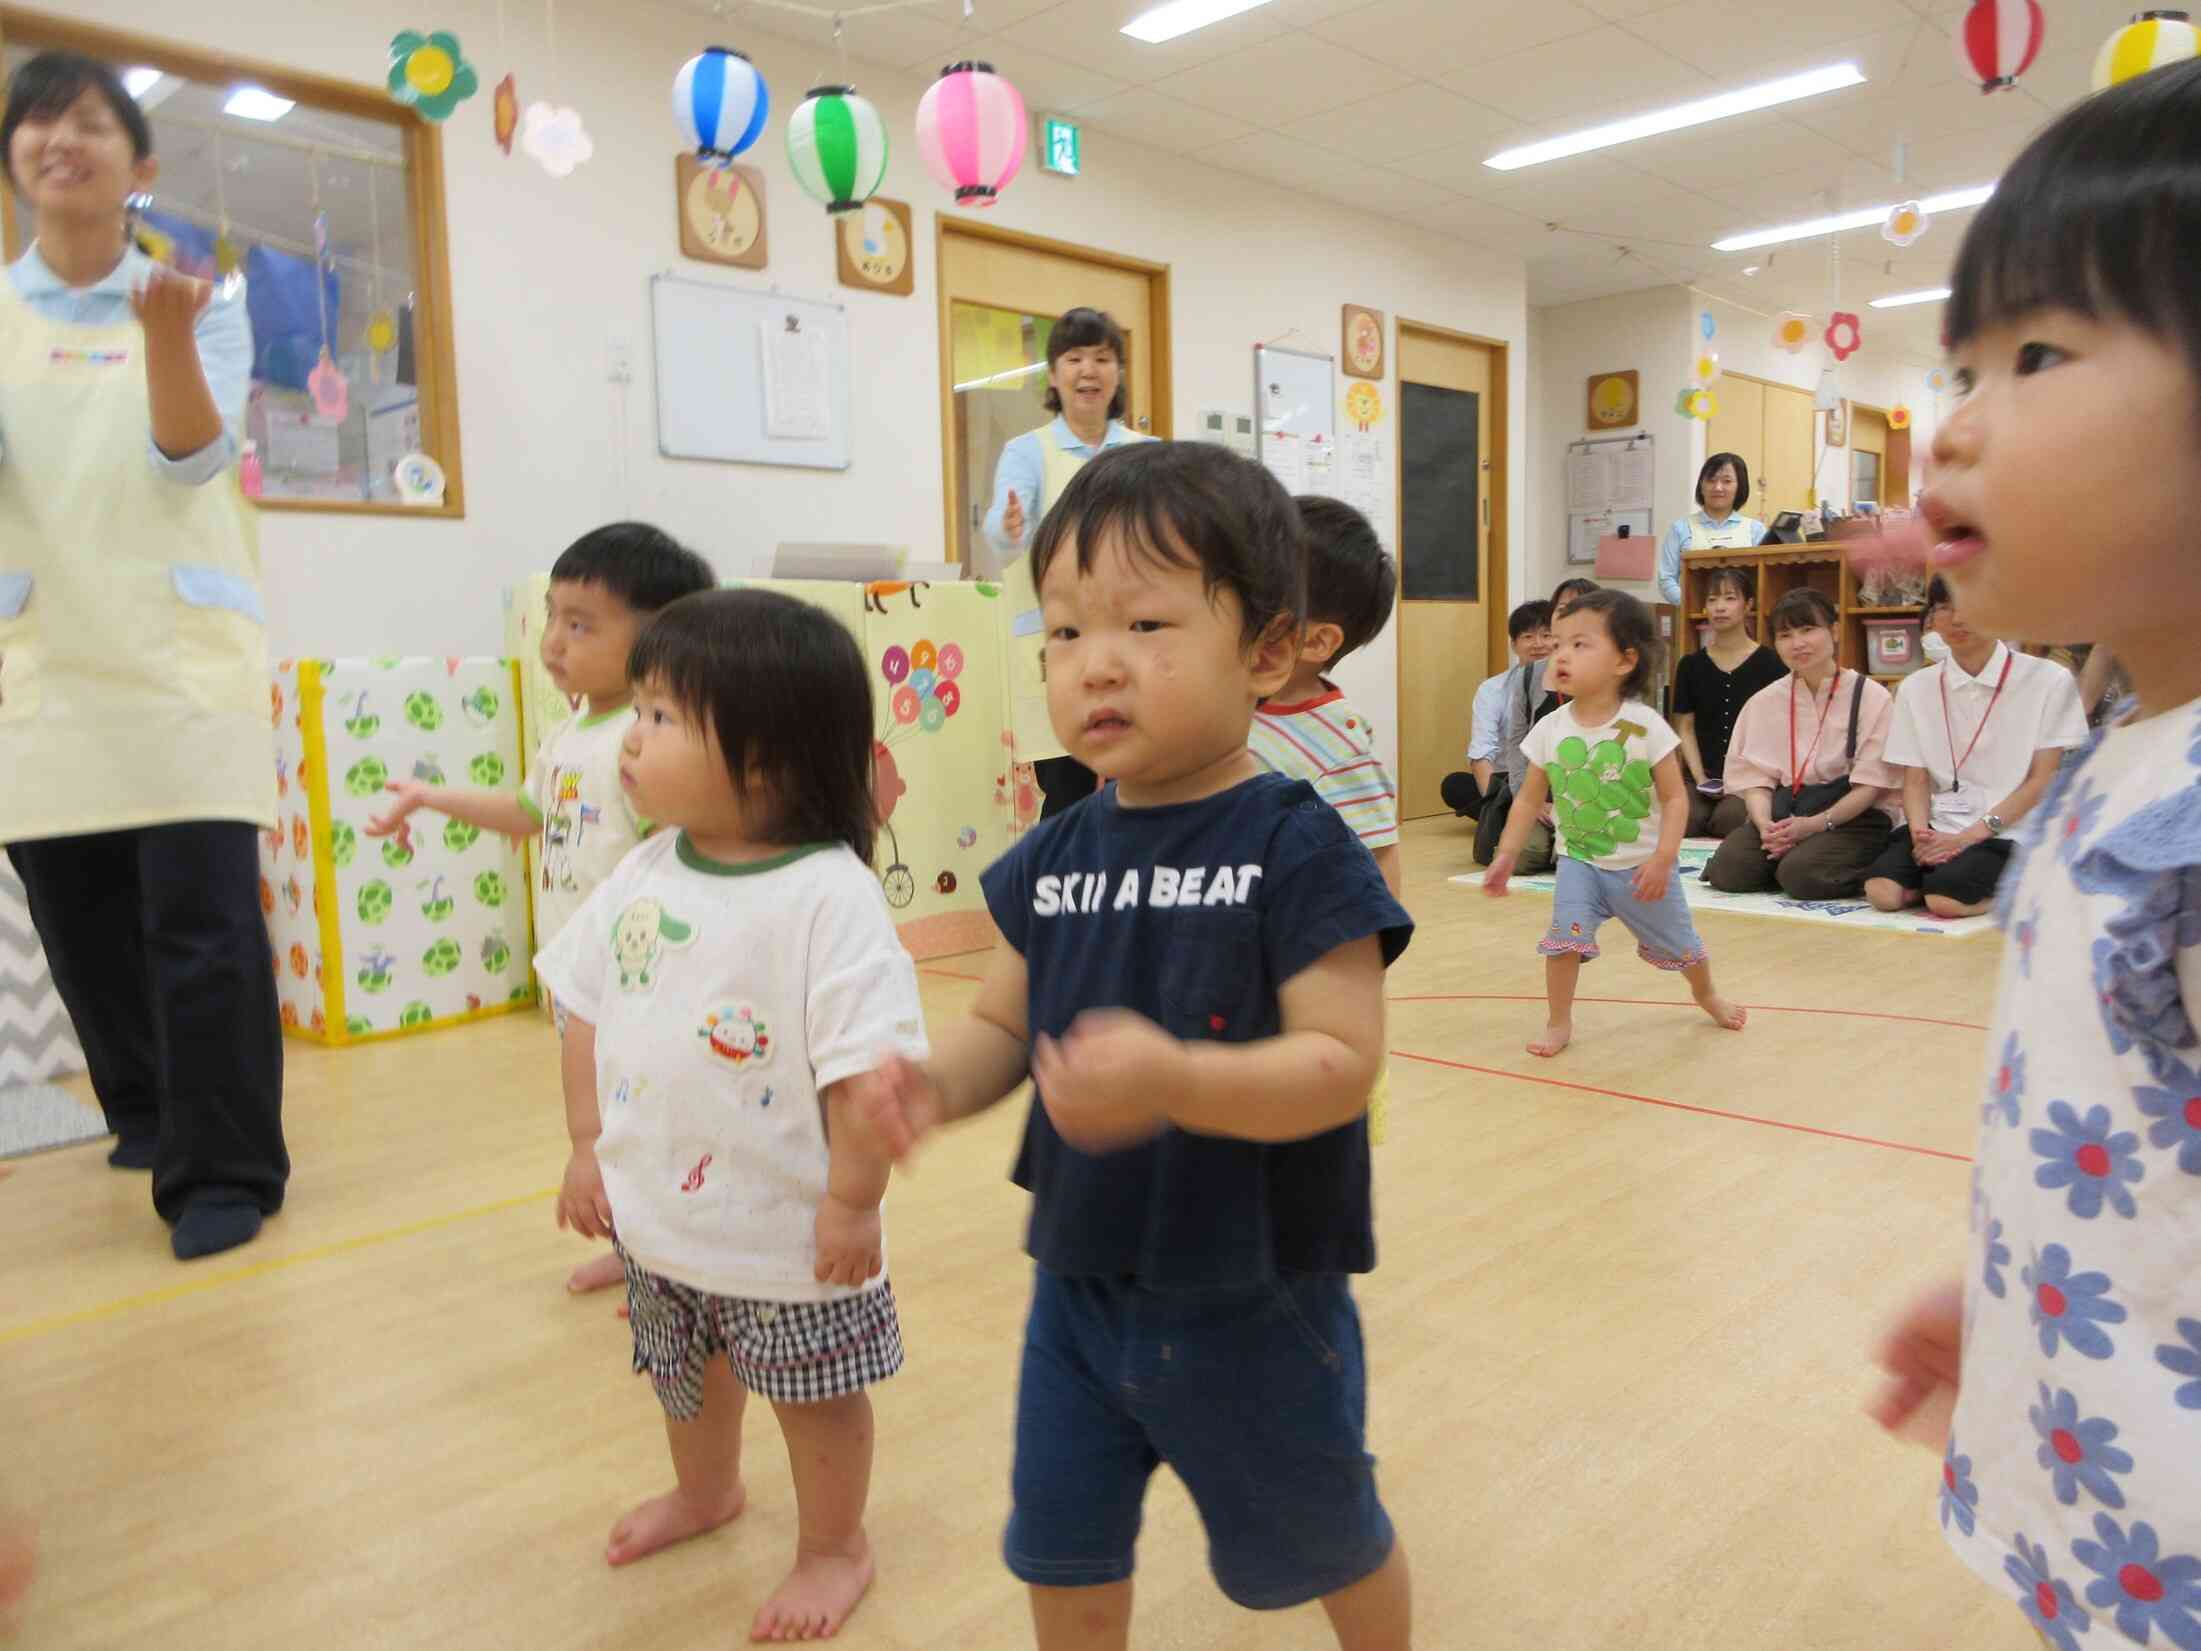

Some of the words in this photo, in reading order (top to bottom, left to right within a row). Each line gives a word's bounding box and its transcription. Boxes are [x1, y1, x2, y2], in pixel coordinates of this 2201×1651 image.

[890, 659, 900, 674] 4
[1113, 868, 1139, 911] A
[1149, 864, 1262, 908] BEAT
